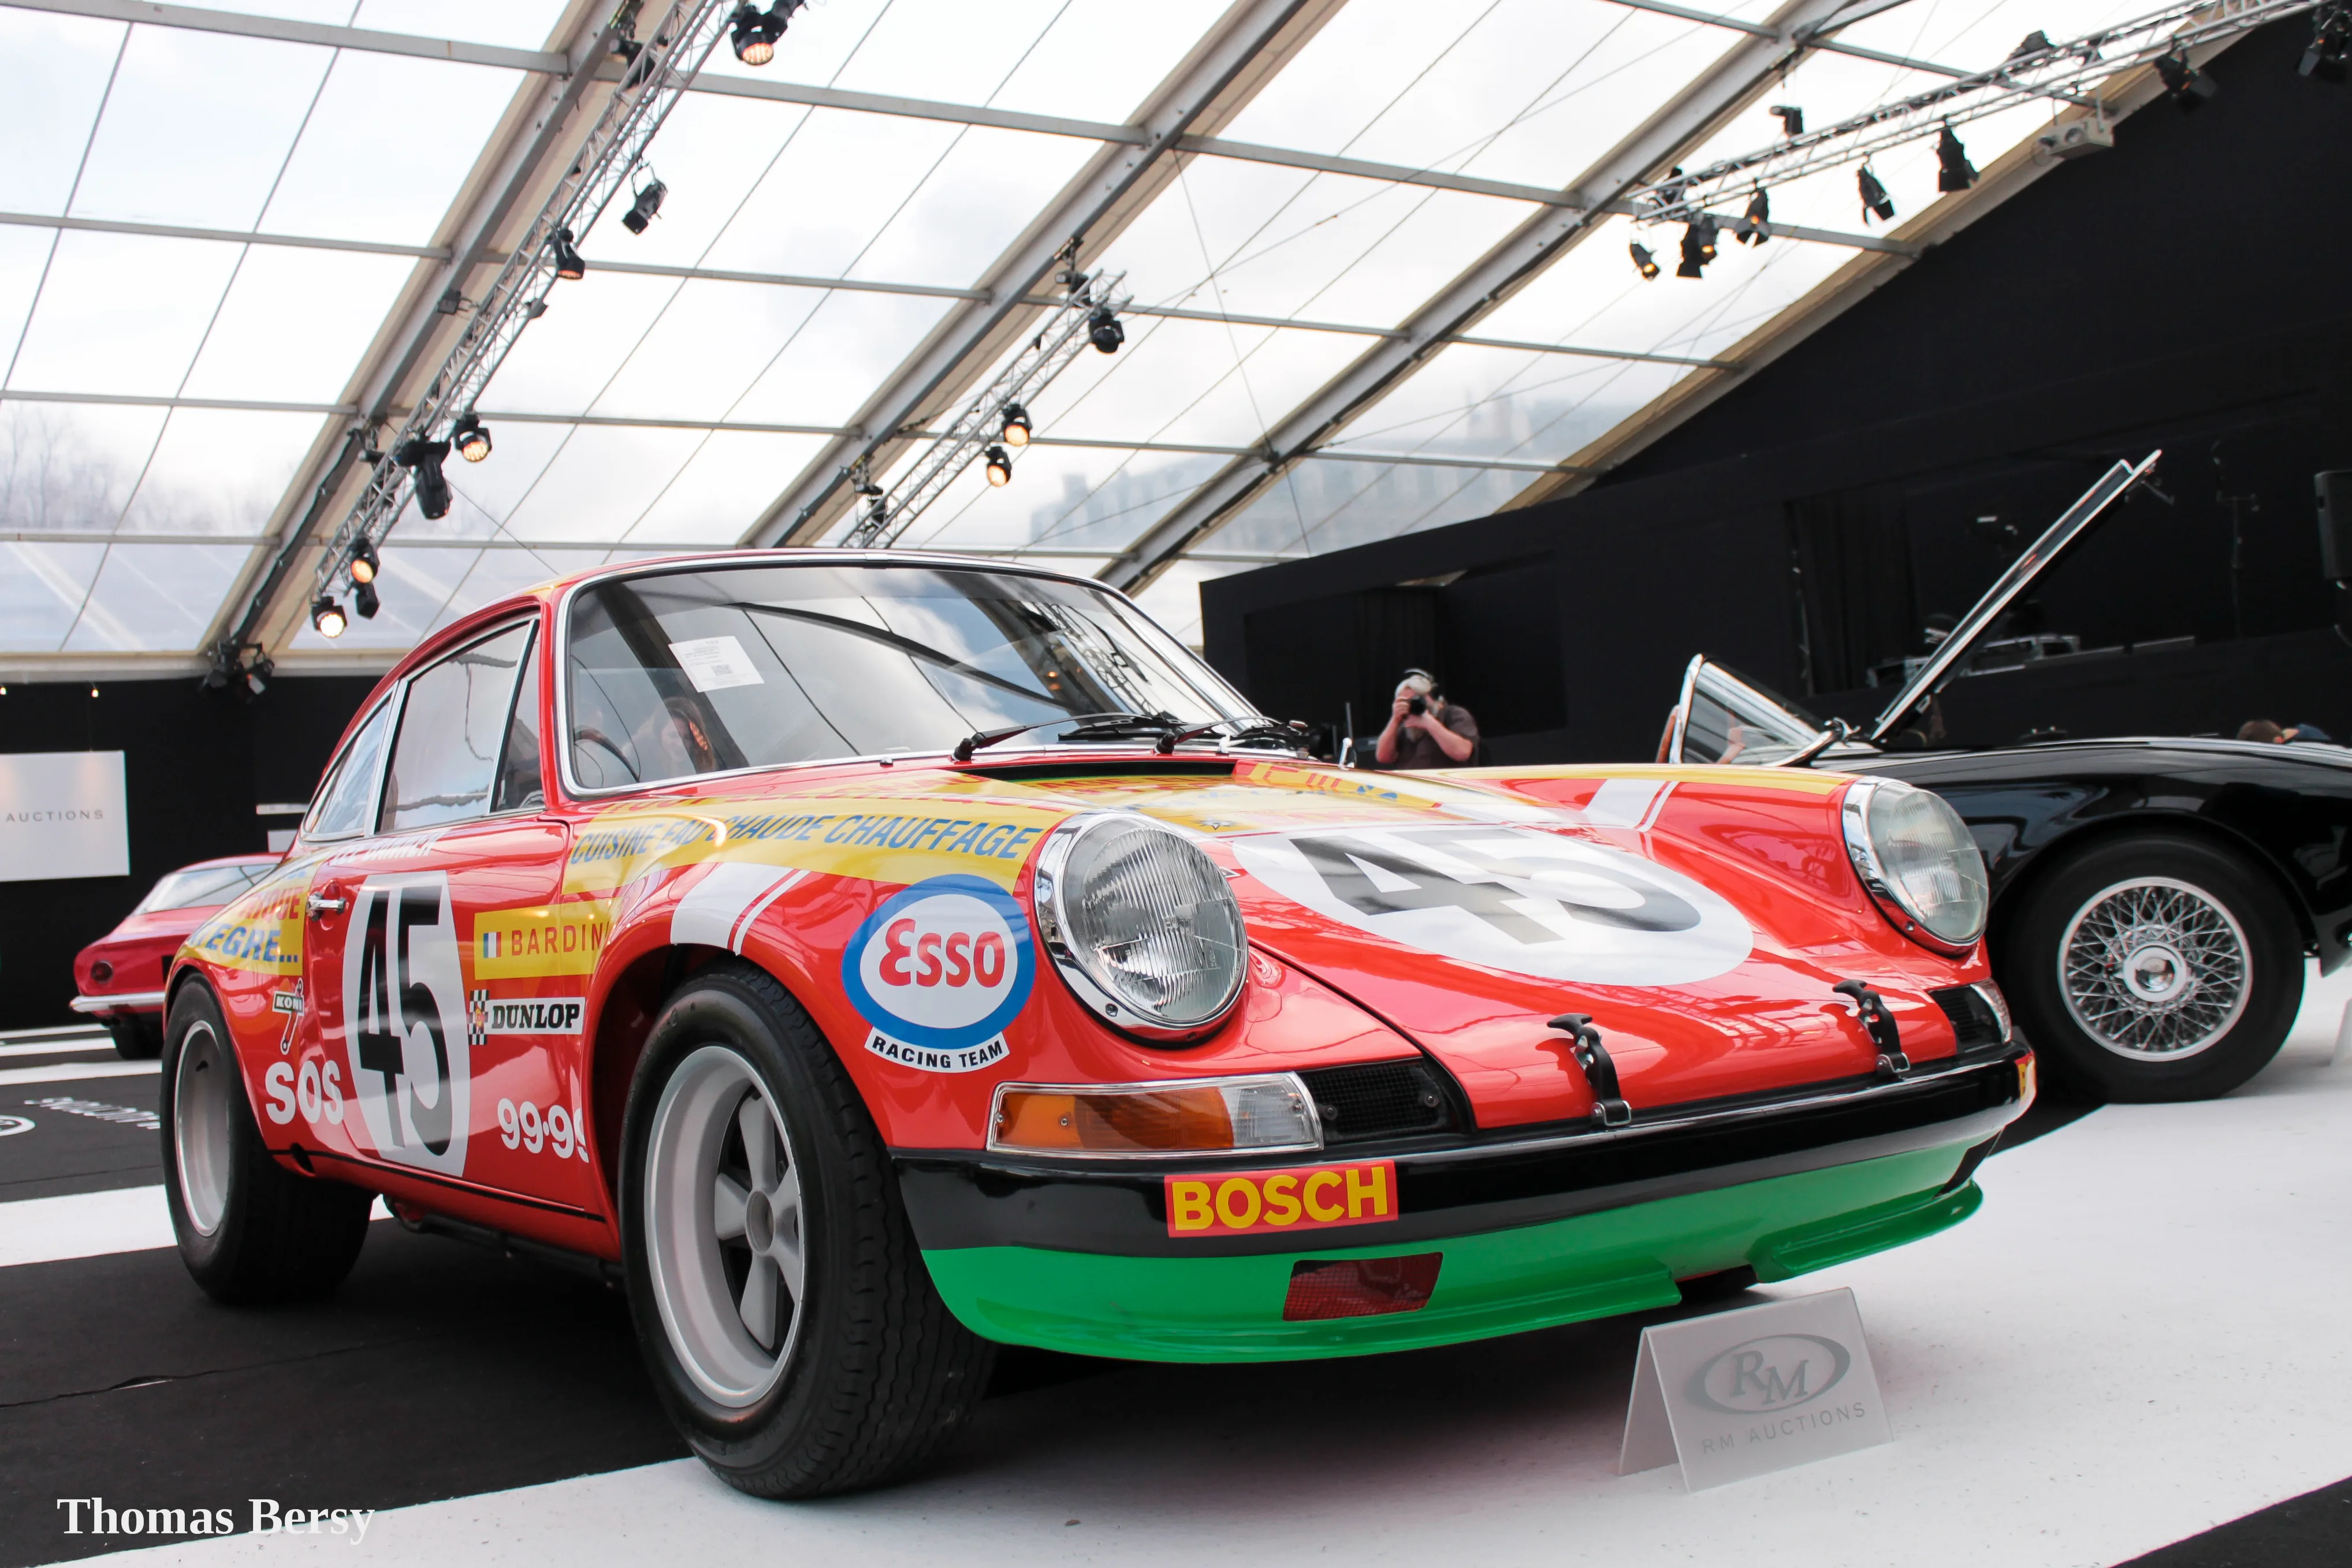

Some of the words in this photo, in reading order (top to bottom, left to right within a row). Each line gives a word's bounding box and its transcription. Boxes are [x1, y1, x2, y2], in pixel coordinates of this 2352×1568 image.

[5, 810, 104, 822] AUCTIONS
[570, 823, 664, 865] CUISINE
[824, 815, 1044, 859] CHAUFFAGE
[1289, 828, 1702, 945] 45
[276, 996, 303, 1012] KONI
[358, 885, 453, 1156] 45
[492, 1004, 580, 1029] DUNLOP
[872, 1036, 951, 1068] RACING
[959, 1040, 1003, 1068] TEAM
[265, 1060, 344, 1125] SOS
[1171, 1167, 1388, 1231] BOSCH
[1729, 1350, 1809, 1406] RM
[1702, 1434, 1734, 1455] RM
[1750, 1402, 1866, 1444] AUCTIONS
